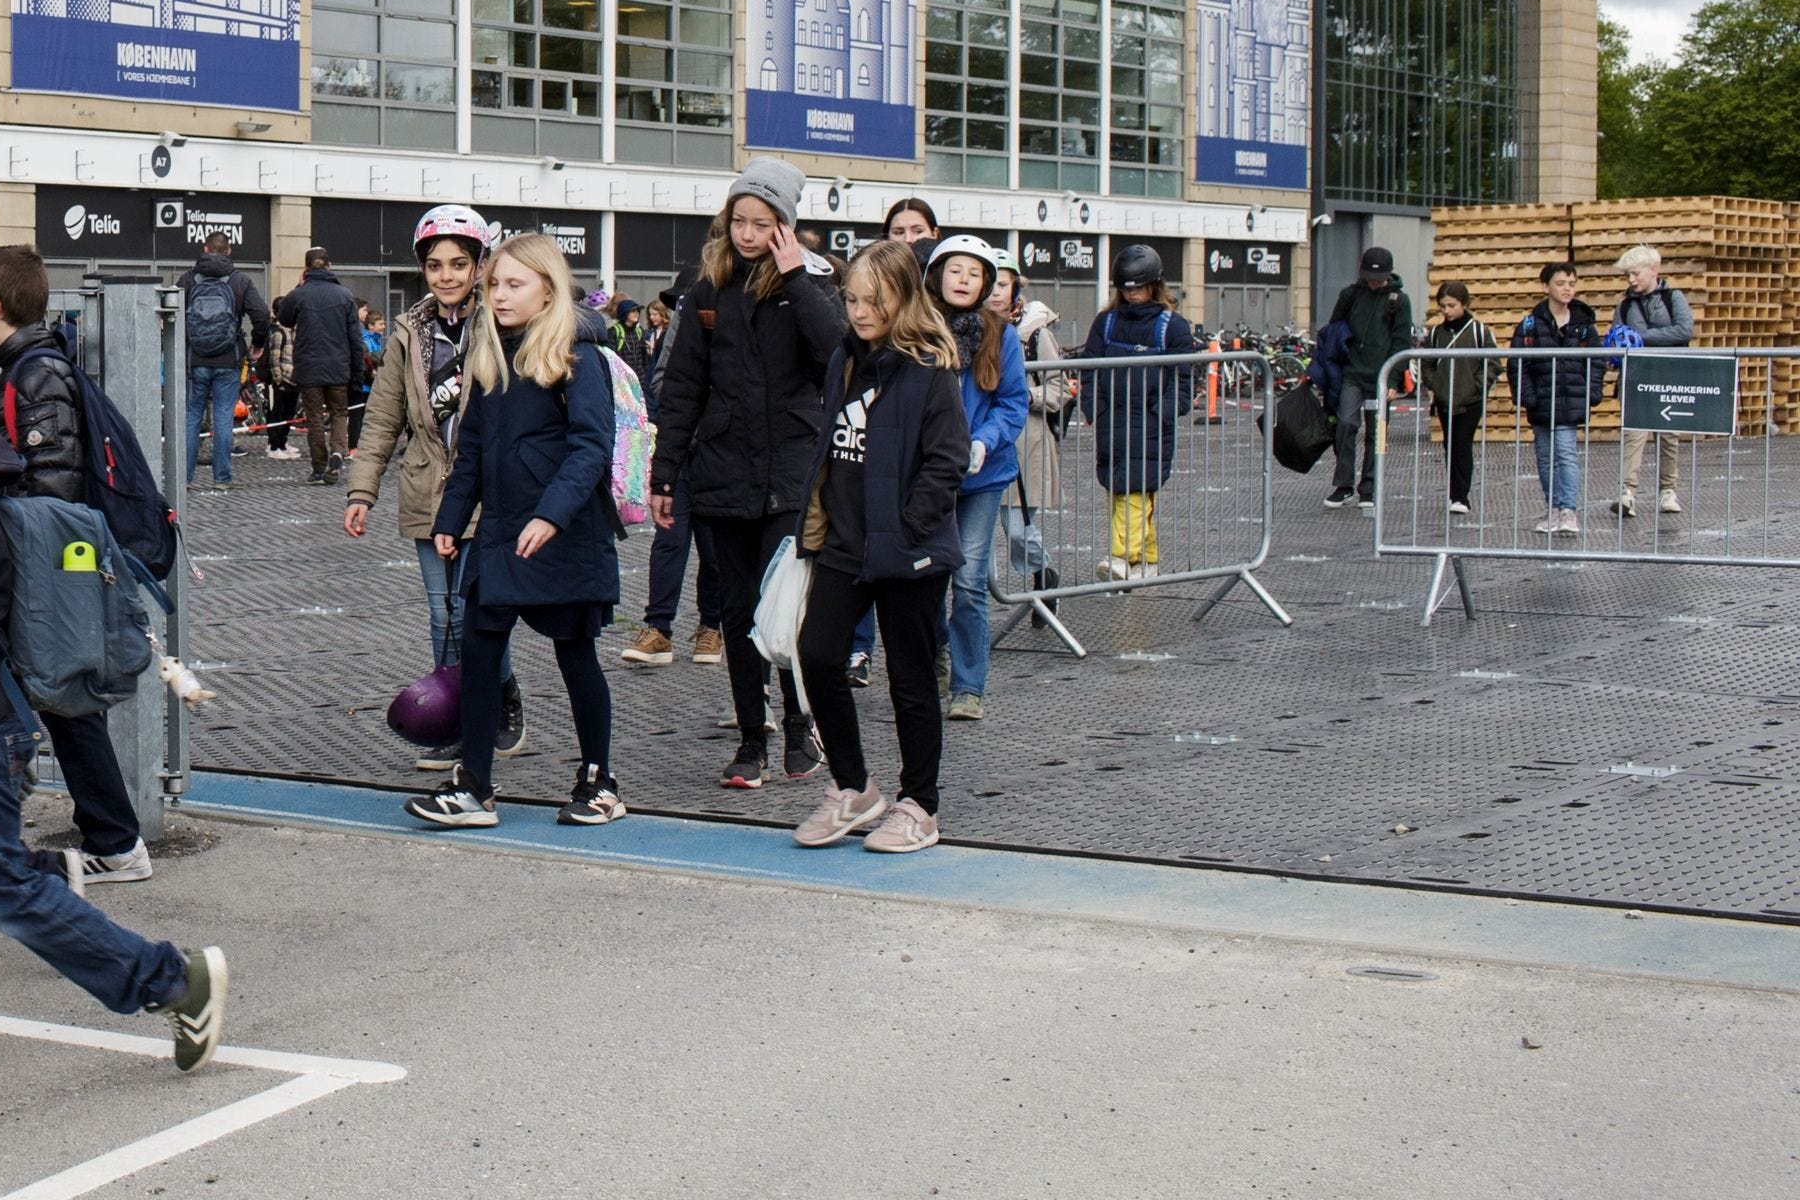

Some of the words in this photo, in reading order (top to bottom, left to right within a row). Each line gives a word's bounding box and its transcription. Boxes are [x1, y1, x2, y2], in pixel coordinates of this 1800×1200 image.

[117, 42, 196, 72] KØBENHAVN
[154, 156, 168, 168] A7
[185, 209, 206, 223] Telia
[87, 213, 121, 235] Telia
[556, 236, 586, 255] RKEN
[1637, 383, 1721, 396] CYKELPARKERING
[1659, 395, 1696, 404] ELEVER
